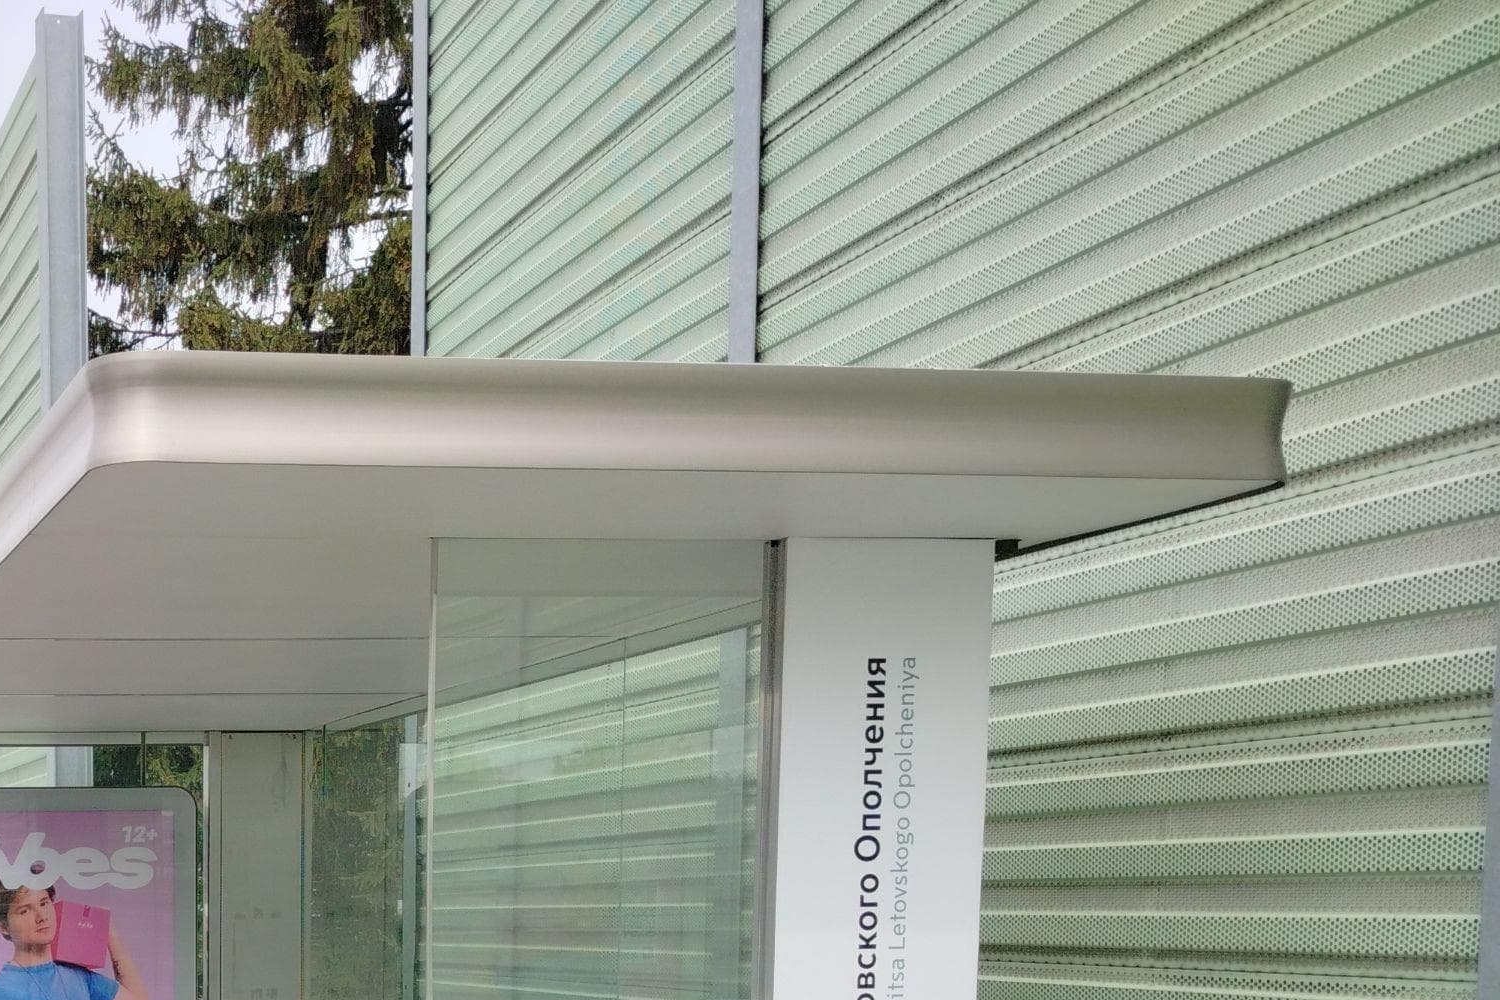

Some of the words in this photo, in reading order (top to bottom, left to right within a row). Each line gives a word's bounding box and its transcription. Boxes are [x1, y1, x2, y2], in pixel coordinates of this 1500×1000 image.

[853, 657, 887, 862] Ополчения
[892, 656, 920, 810] Opolcheniya
[121, 825, 158, 843] 12+
[887, 816, 914, 950] Letovskogo
